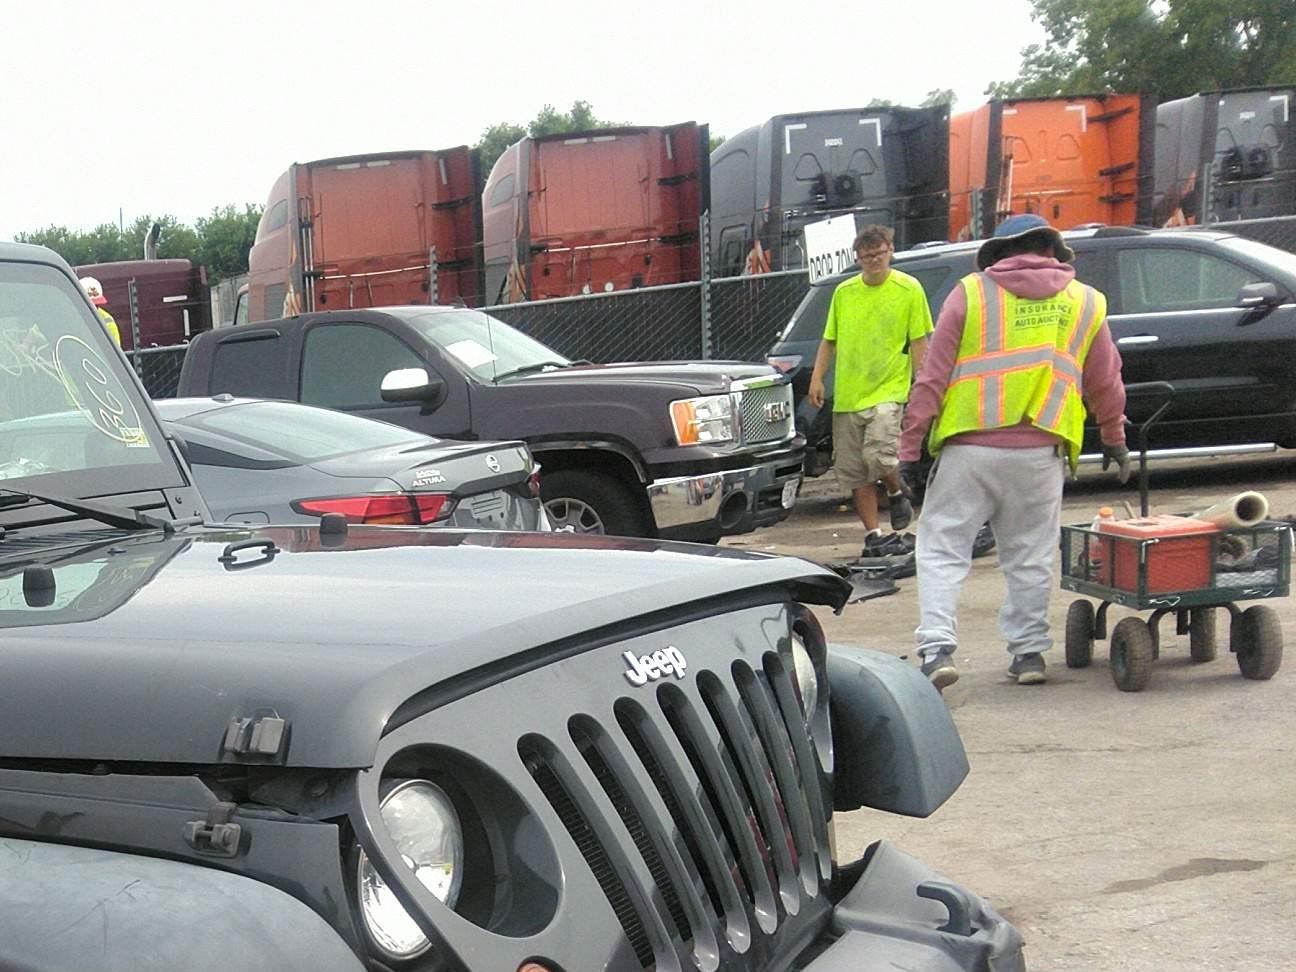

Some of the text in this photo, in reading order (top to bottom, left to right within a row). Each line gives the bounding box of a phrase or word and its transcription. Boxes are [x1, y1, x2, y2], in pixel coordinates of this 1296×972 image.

[810, 248, 857, 281] DROP ZON
[623, 645, 687, 687] Jeep
